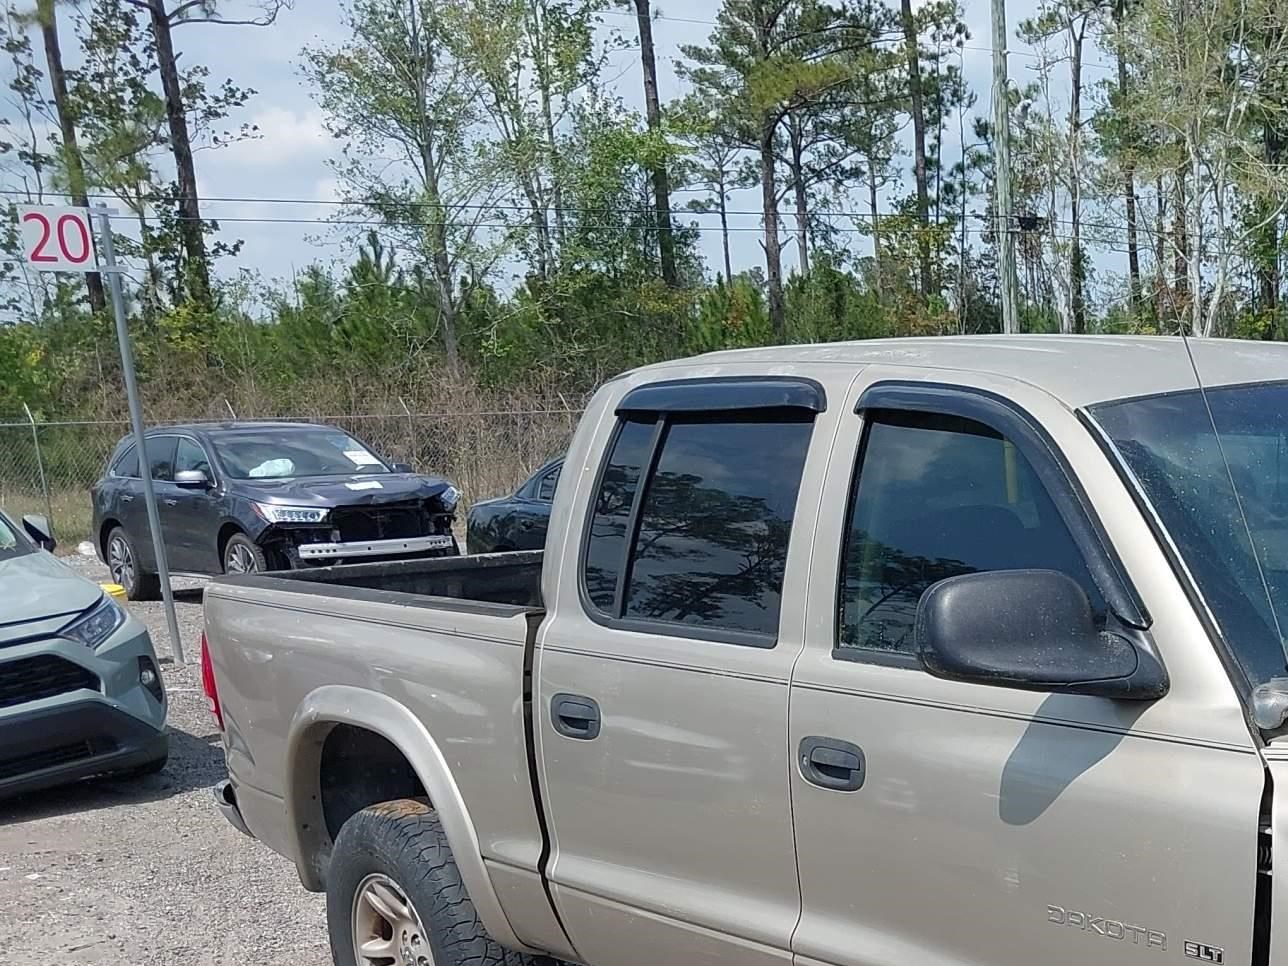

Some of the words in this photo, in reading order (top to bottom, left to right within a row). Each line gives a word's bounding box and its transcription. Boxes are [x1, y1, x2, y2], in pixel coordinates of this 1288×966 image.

[23, 213, 90, 263] 20
[1047, 904, 1167, 951] DAKOTA
[1185, 941, 1222, 963] SLT
